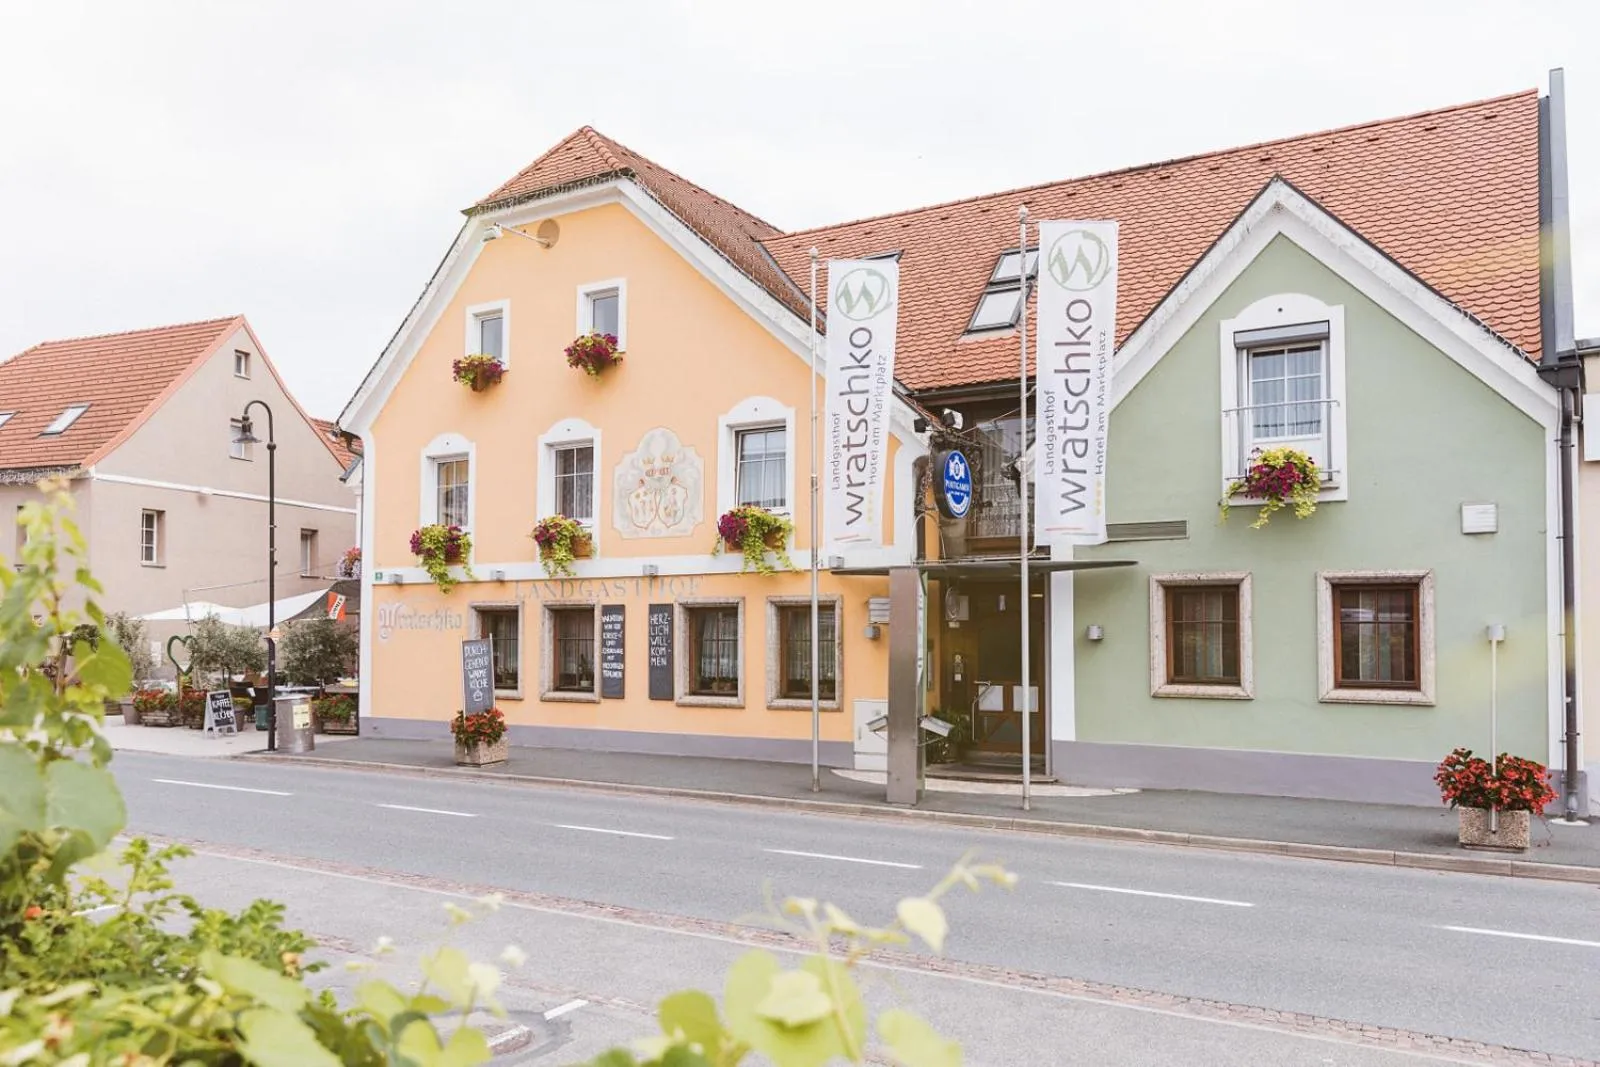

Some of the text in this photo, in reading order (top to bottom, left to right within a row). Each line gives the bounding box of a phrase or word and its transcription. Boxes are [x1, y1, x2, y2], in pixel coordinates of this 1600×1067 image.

[839, 327, 872, 525] wratschko
[868, 353, 887, 485] Hotel am Marktplatz
[1044, 390, 1057, 475] Landgasthof
[1054, 299, 1092, 515] wratschko
[1094, 330, 1107, 475] Hotel am Marktplatz
[831, 412, 841, 490] Landgasthof
[515, 576, 704, 599] LANDGASTHOF
[650, 625, 669, 636] LICH
[650, 656, 668, 666] MEN
